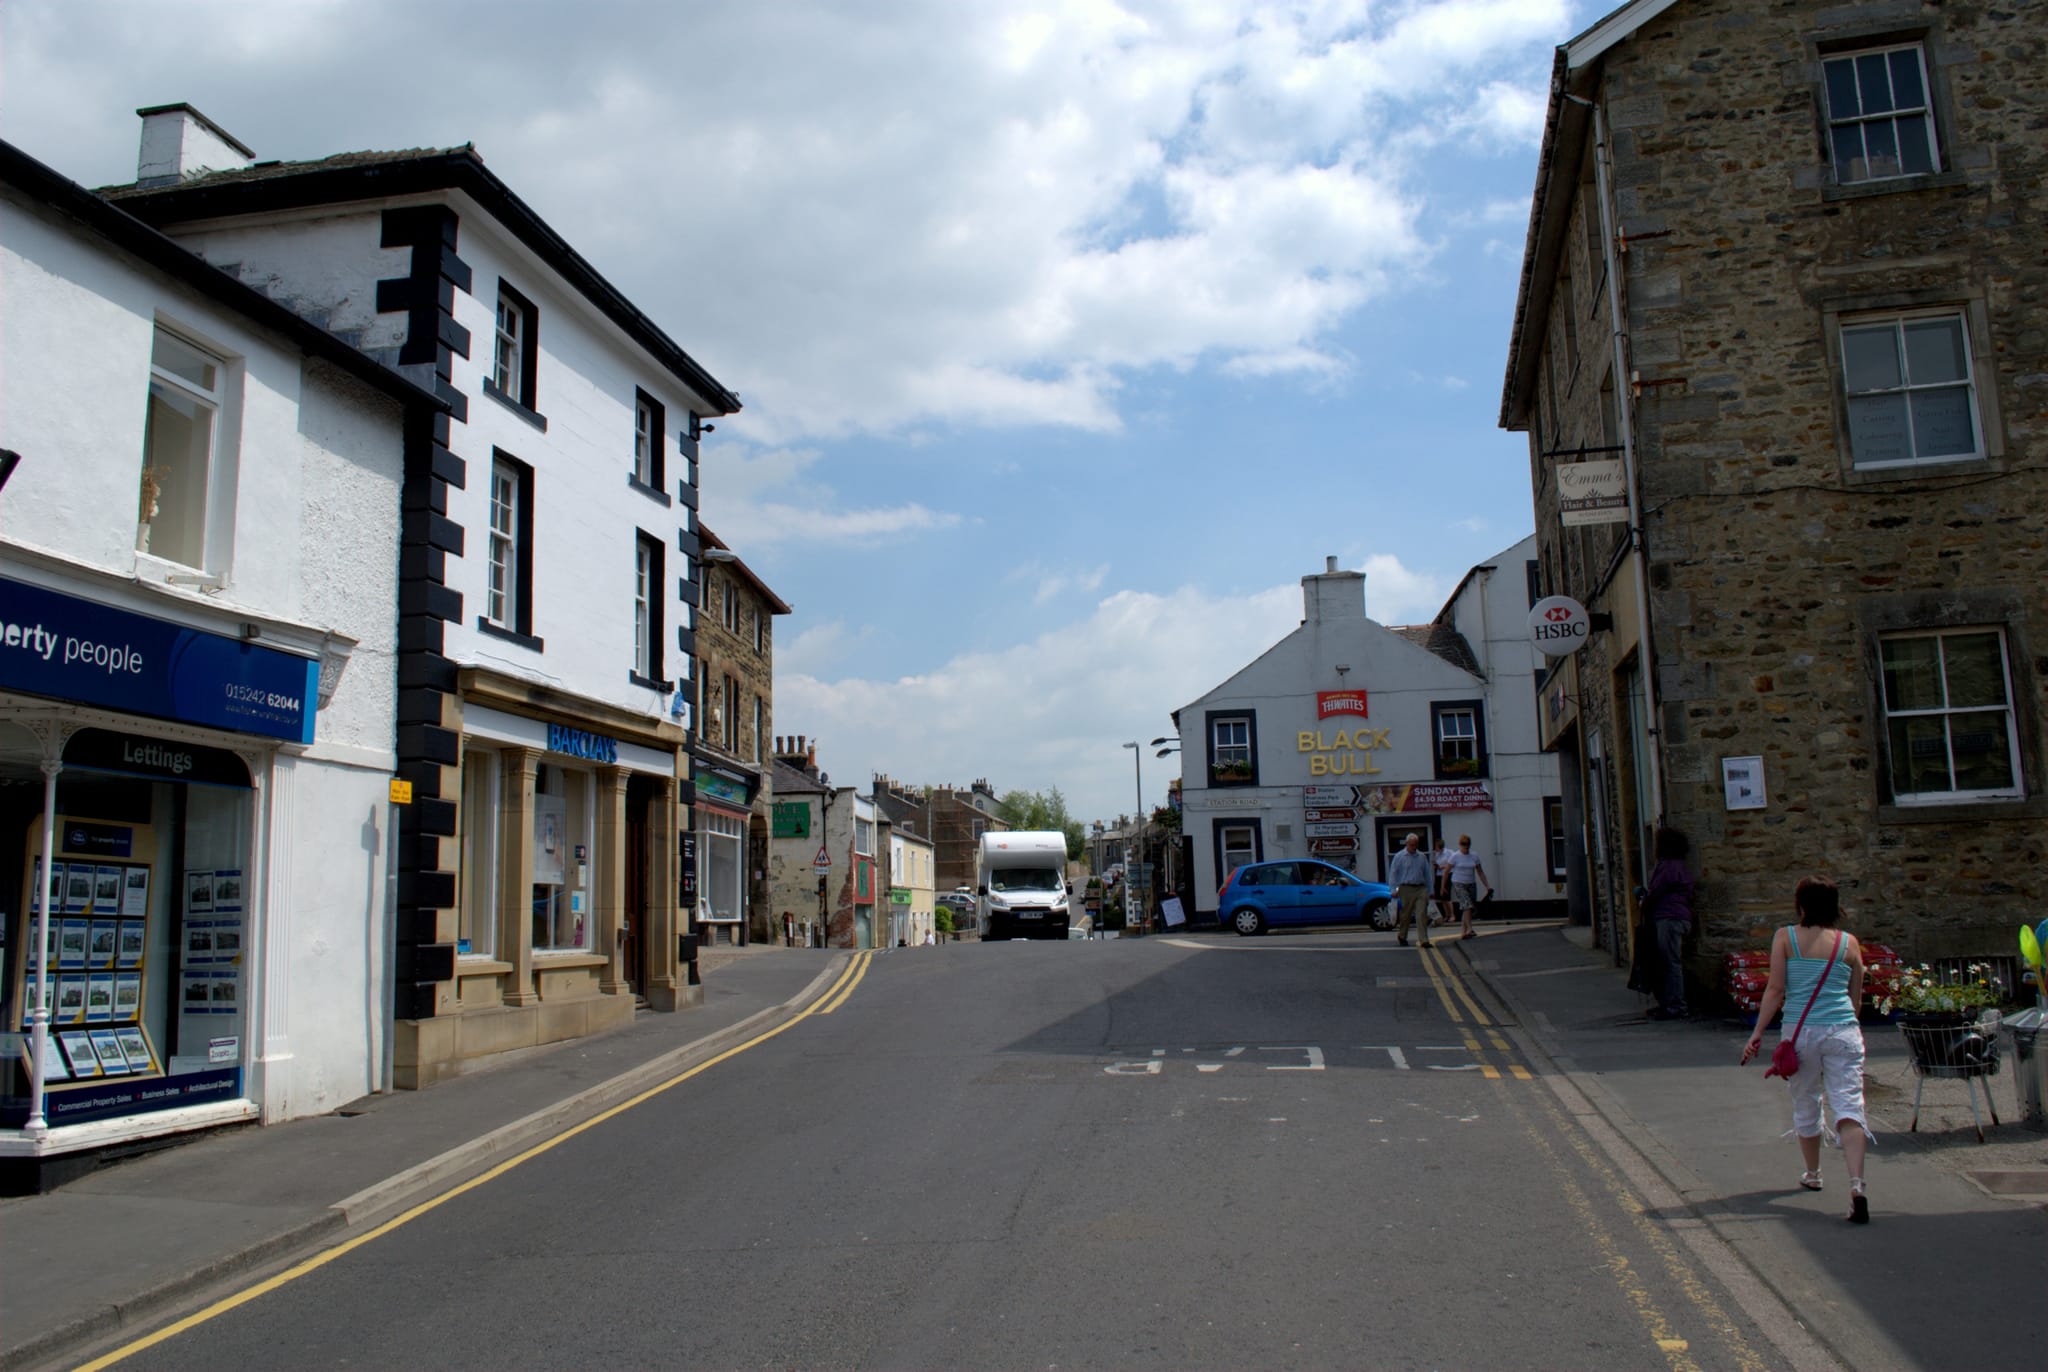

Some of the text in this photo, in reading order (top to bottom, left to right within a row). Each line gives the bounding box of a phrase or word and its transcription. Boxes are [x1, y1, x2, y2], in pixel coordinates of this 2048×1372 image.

[1559, 463, 1623, 487] Emma's
[1563, 497, 1625, 510] Hair & Beauty
[1534, 621, 1586, 640] HSBC
[0, 620, 143, 675] erty people
[225, 683, 300, 712] 015242 62044
[1321, 699, 1364, 712] THWAITES
[549, 722, 617, 763] BARCLAYS
[1297, 727, 1393, 752] BLACK
[123, 740, 193, 774] Lettings
[1310, 751, 1382, 776] BULL
[1414, 786, 1455, 796] SUNDAY
[1436, 794, 1462, 802] ROAST
[57, 1093, 132, 1112] Commercial Property Sales
[141, 1087, 180, 1100] Business Sales
